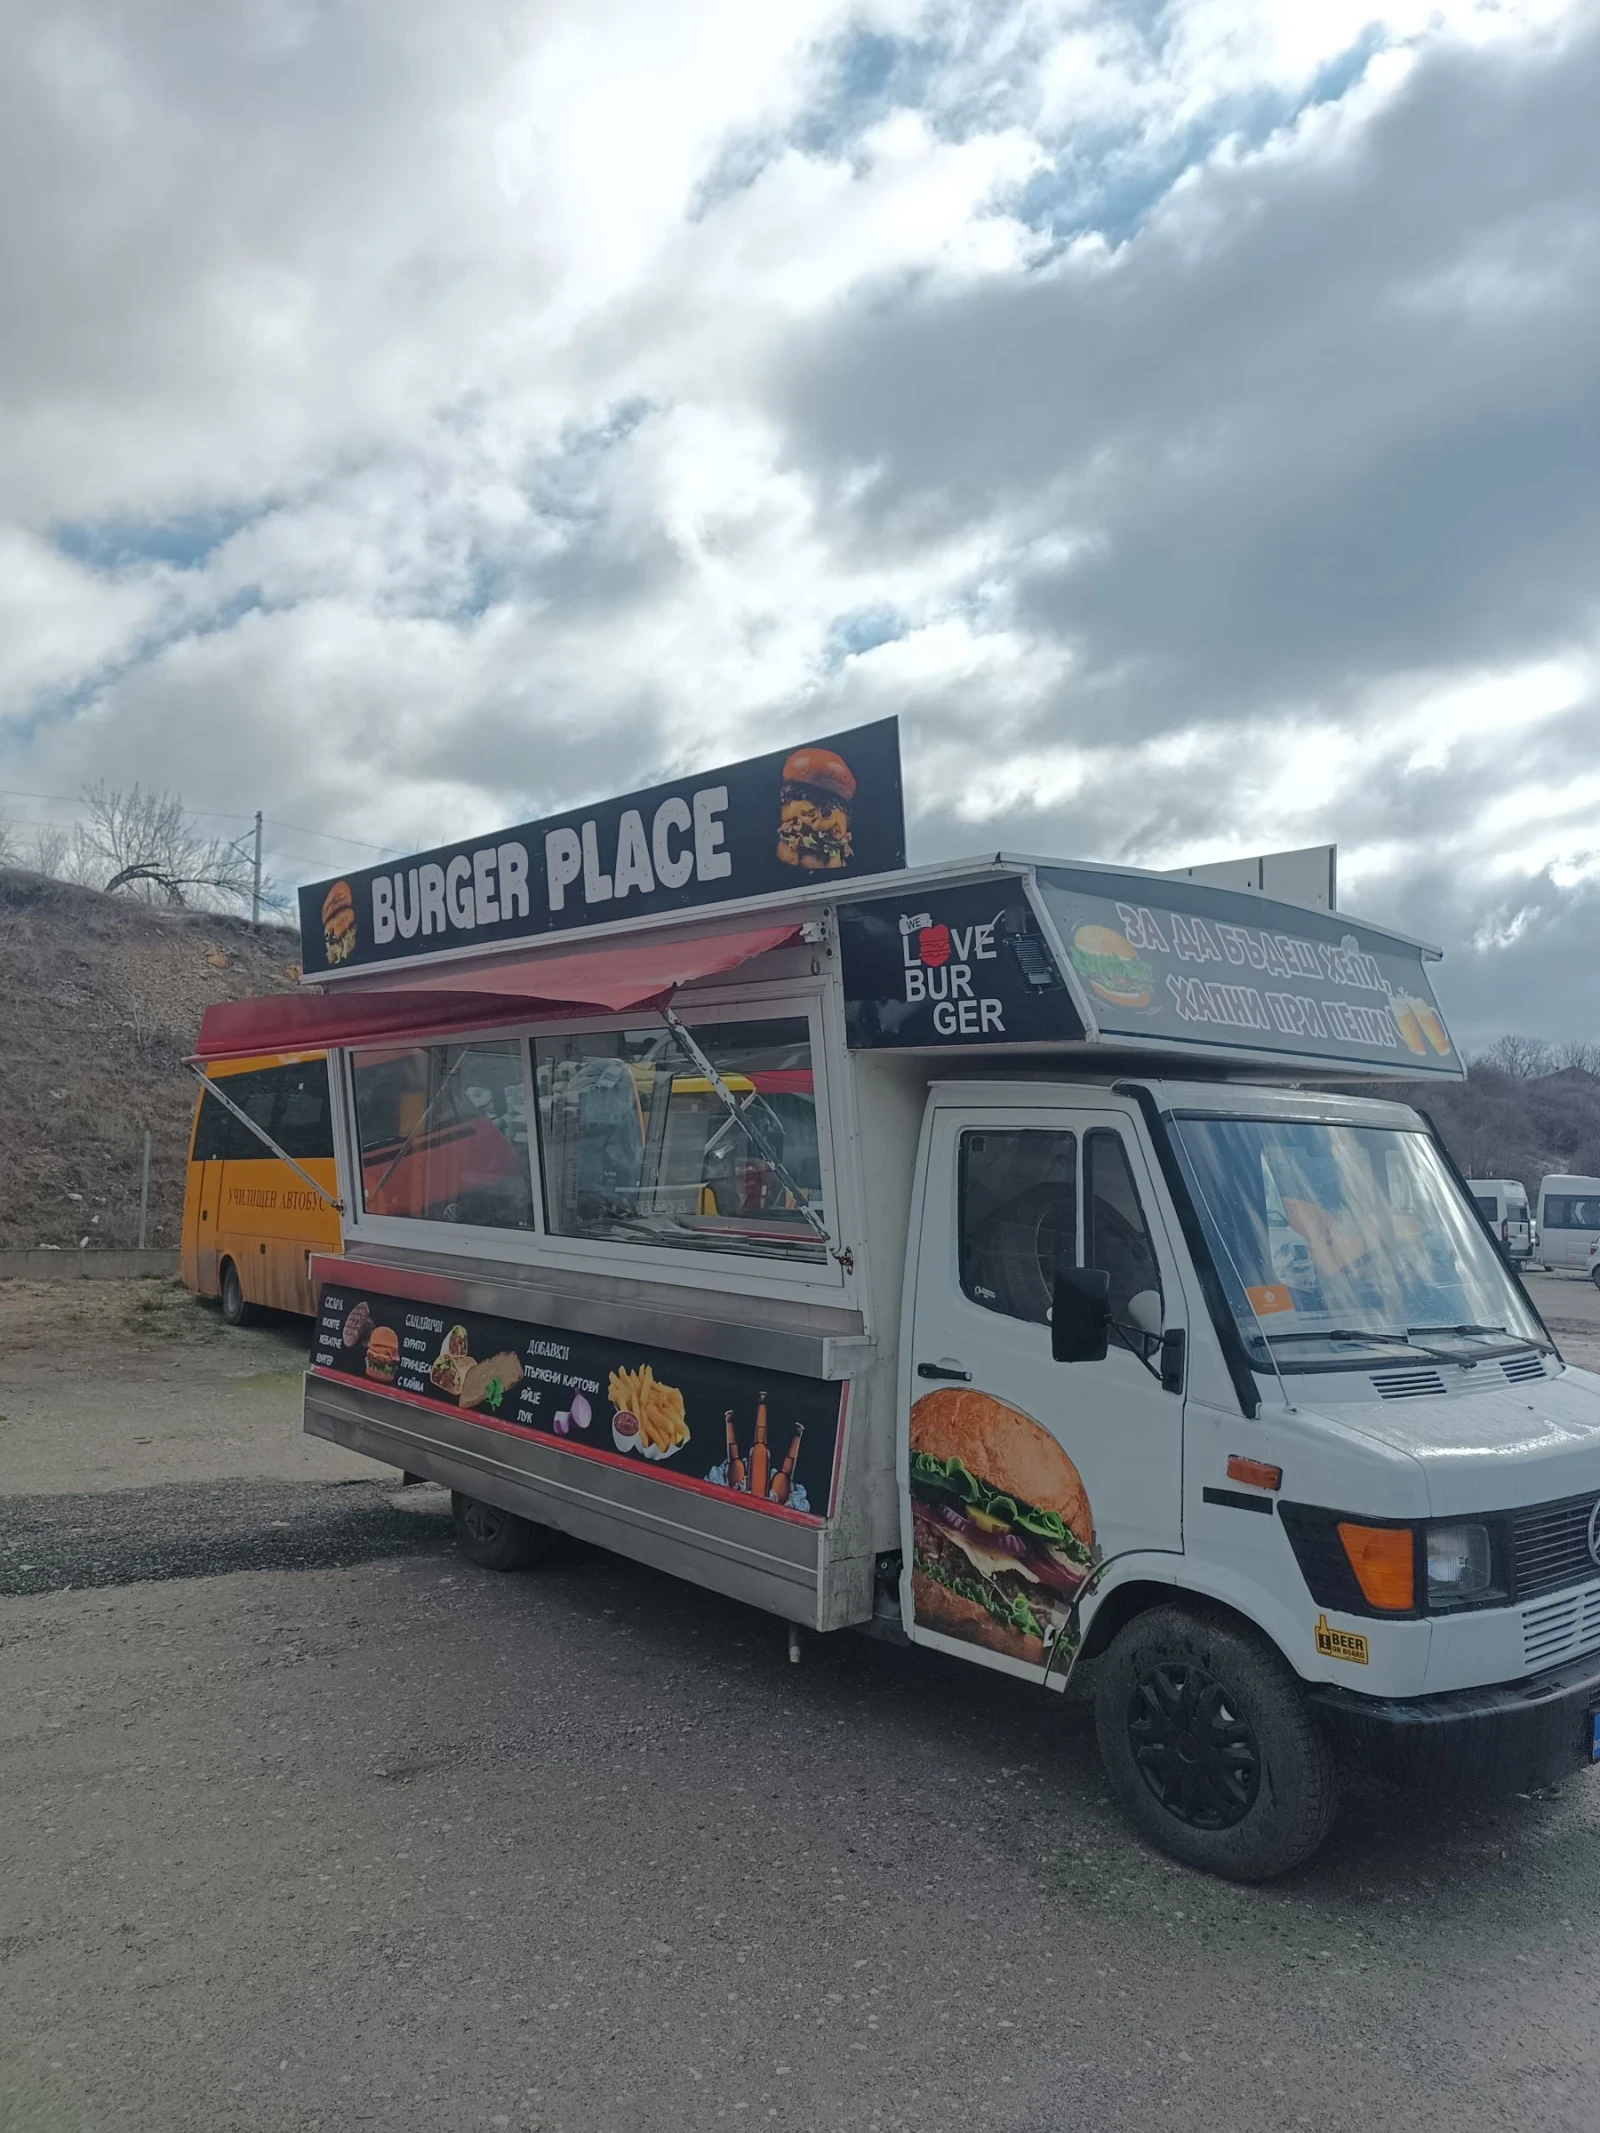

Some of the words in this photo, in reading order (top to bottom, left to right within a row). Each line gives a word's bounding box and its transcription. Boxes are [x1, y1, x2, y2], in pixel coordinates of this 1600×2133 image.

[371, 841, 530, 944] BURGER
[545, 785, 732, 910] PLACE
[906, 917, 922, 931] WE
[1115, 902, 1170, 952] ЗА
[1170, 913, 1221, 962] ДА
[905, 964, 975, 1002] BUR
[933, 998, 1006, 1035] GER
[1166, 974, 1270, 1030] ХАПНИ
[1265, 992, 1328, 1038] ПРИ
[526, 1339, 570, 1361] ДОБАВКИ
[524, 1364, 561, 1385] ПЪРЖЕНИ
[519, 1386, 541, 1405] ЯЙЦЕ
[517, 1409, 533, 1424] ЛУК
[1331, 1633, 1364, 1652] BEER
[1332, 1645, 1341, 1653] ON
[1342, 1648, 1364, 1659] BOARD
